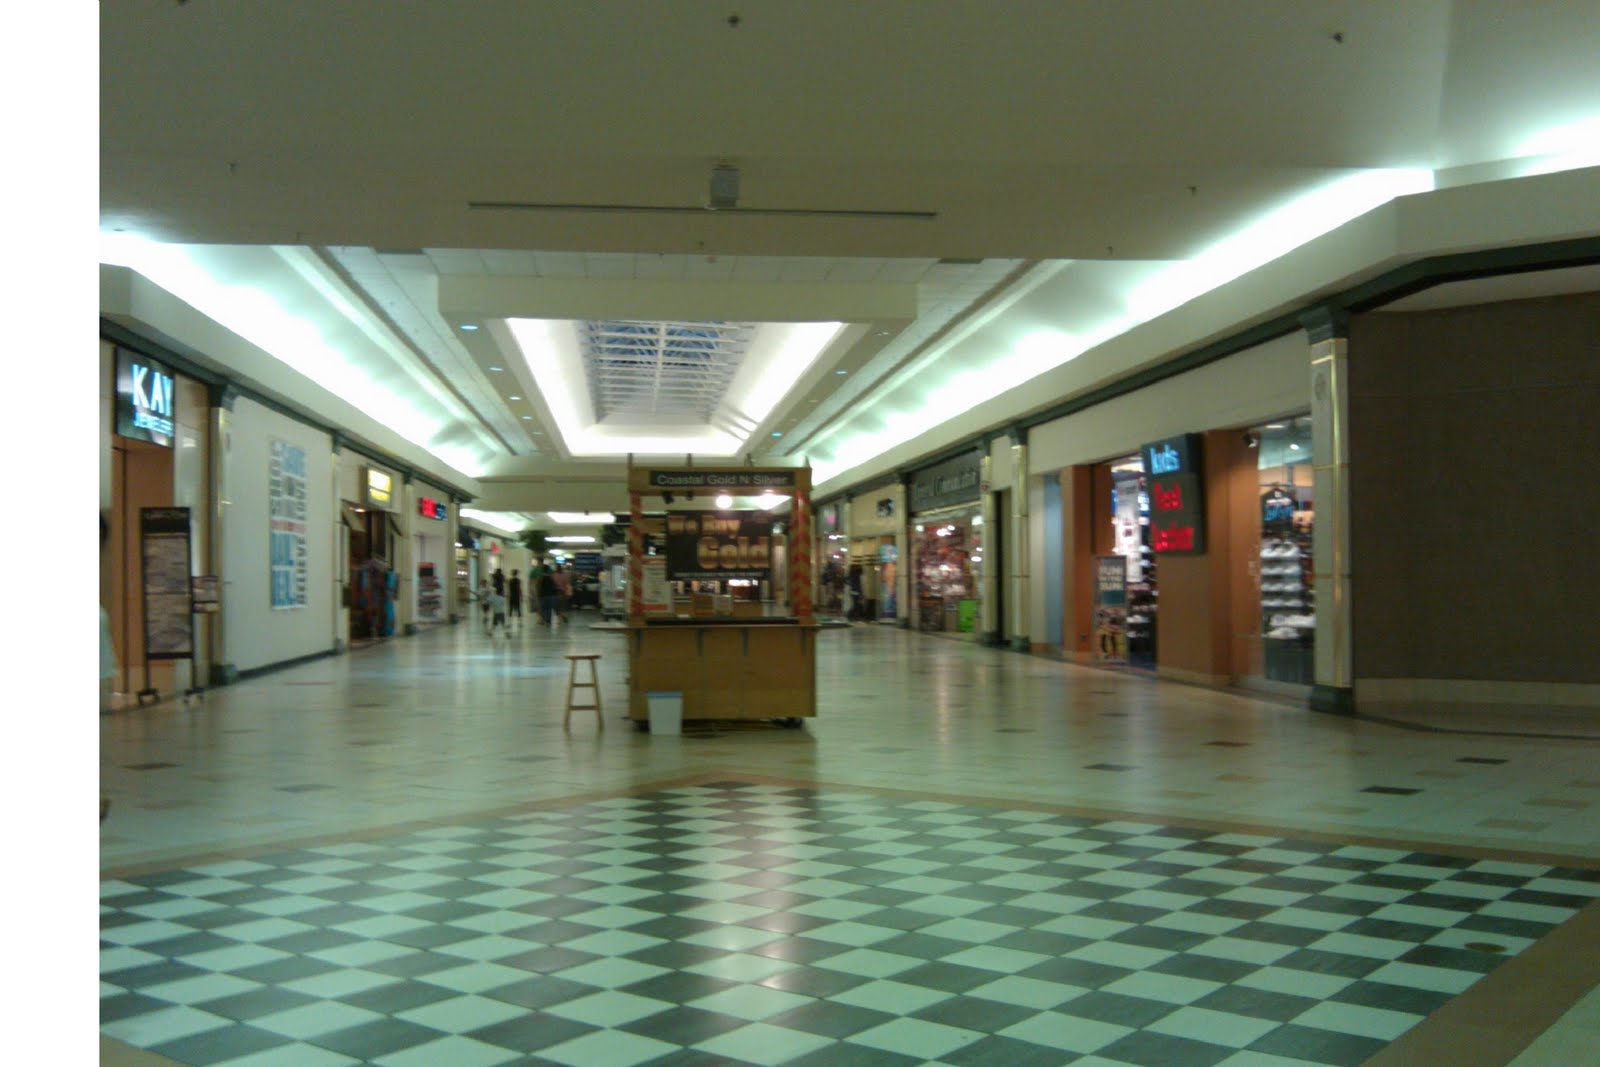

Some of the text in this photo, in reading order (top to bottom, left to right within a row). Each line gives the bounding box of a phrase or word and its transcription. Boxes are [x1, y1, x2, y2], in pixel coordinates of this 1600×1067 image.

[132, 364, 173, 417] KAY
[657, 474, 704, 485] Coastal
[707, 473, 736, 485] Gold
[753, 473, 787, 485] Silver
[697, 535, 770, 570] Gold
